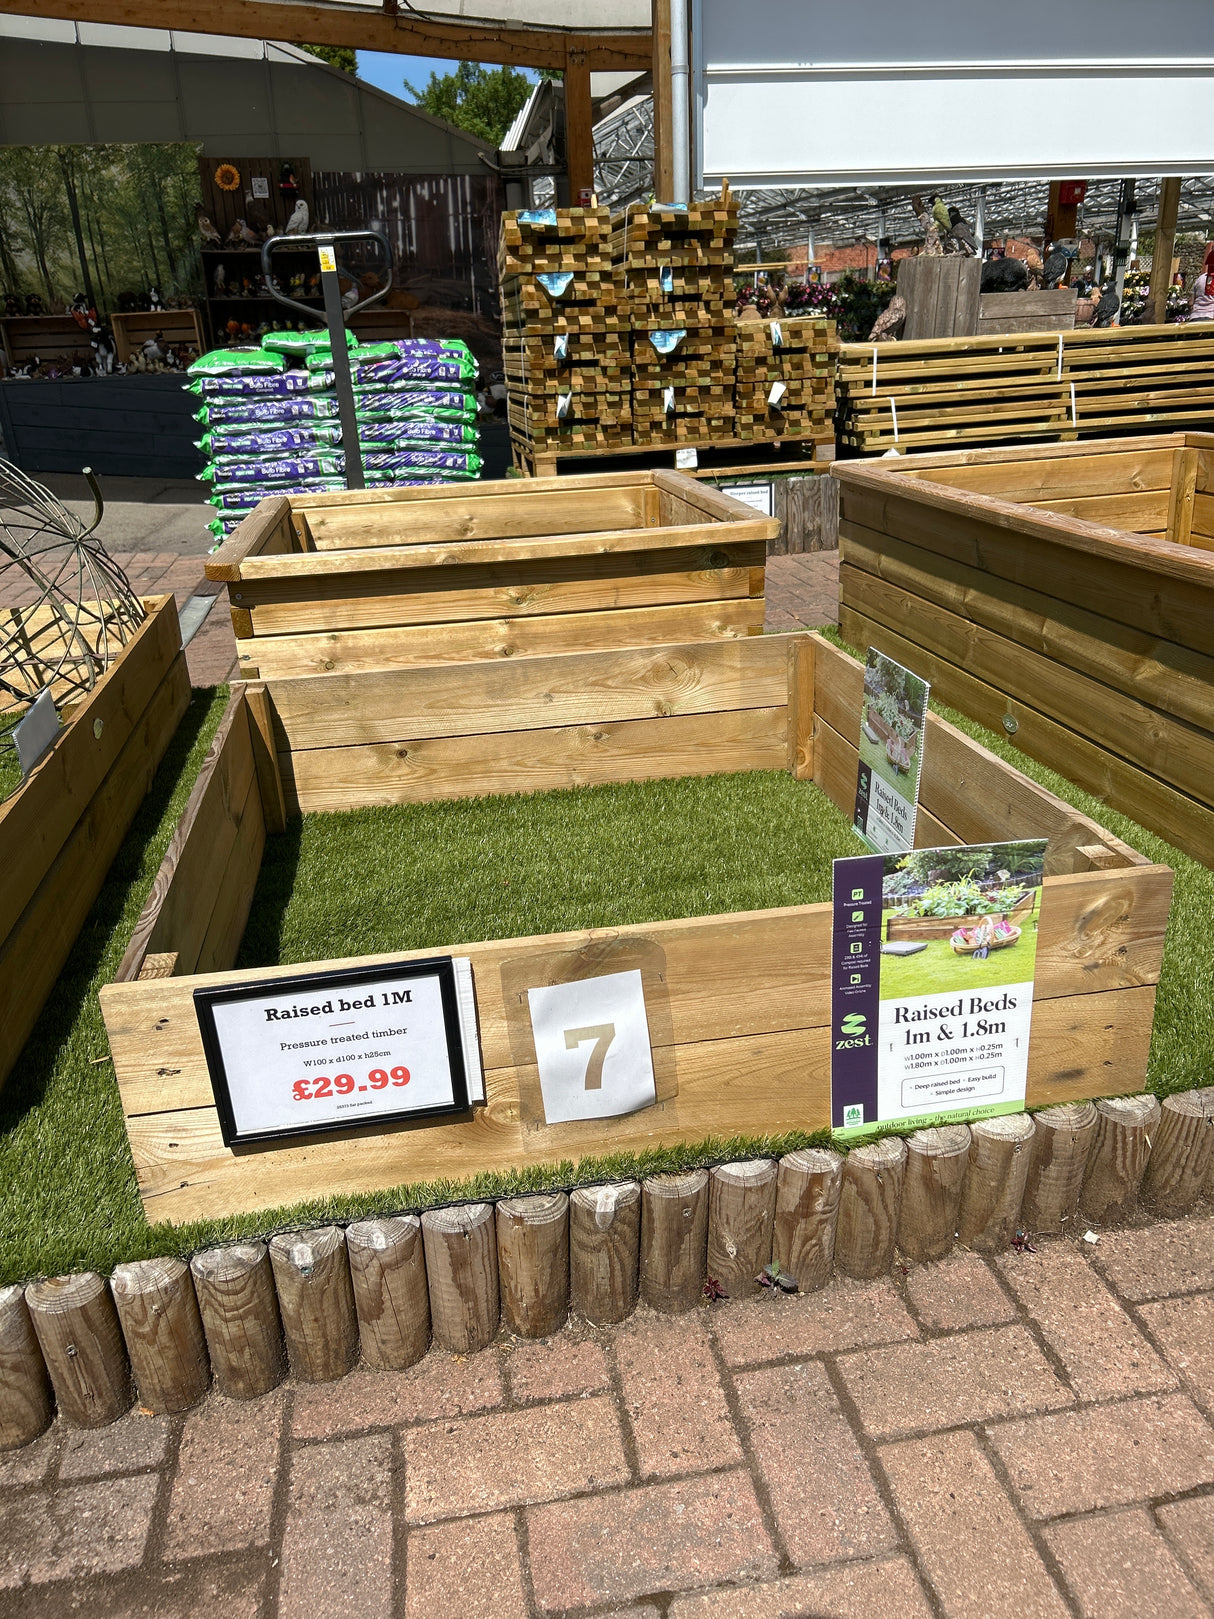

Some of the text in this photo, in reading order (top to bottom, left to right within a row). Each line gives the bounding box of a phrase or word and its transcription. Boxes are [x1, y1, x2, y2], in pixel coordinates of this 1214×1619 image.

[875, 782, 907, 821] Raised Beds
[891, 812, 904, 833] 1.8m
[265, 990, 413, 1022] Raised bed 1M
[894, 993, 1017, 1024] Raised Beds
[280, 1026, 408, 1051] Pressure treated timber
[836, 1034, 871, 1050] zest
[905, 1018, 1006, 1045] 1m & 1.8m
[303, 1057, 327, 1067] W100
[336, 1054, 356, 1063] d100
[364, 1050, 391, 1059] h25cm
[564, 1022, 616, 1090] 7
[292, 1065, 411, 1102] £29.99
[915, 1082, 930, 1090] Deep
[968, 1075, 981, 1084] Easy
[935, 1088, 955, 1096] Simple
[876, 1121, 906, 1131] outdoor
[908, 1116, 927, 1126] living
[935, 1112, 946, 1121] the
[948, 1110, 970, 1120] natural
[972, 1107, 995, 1115] choice
